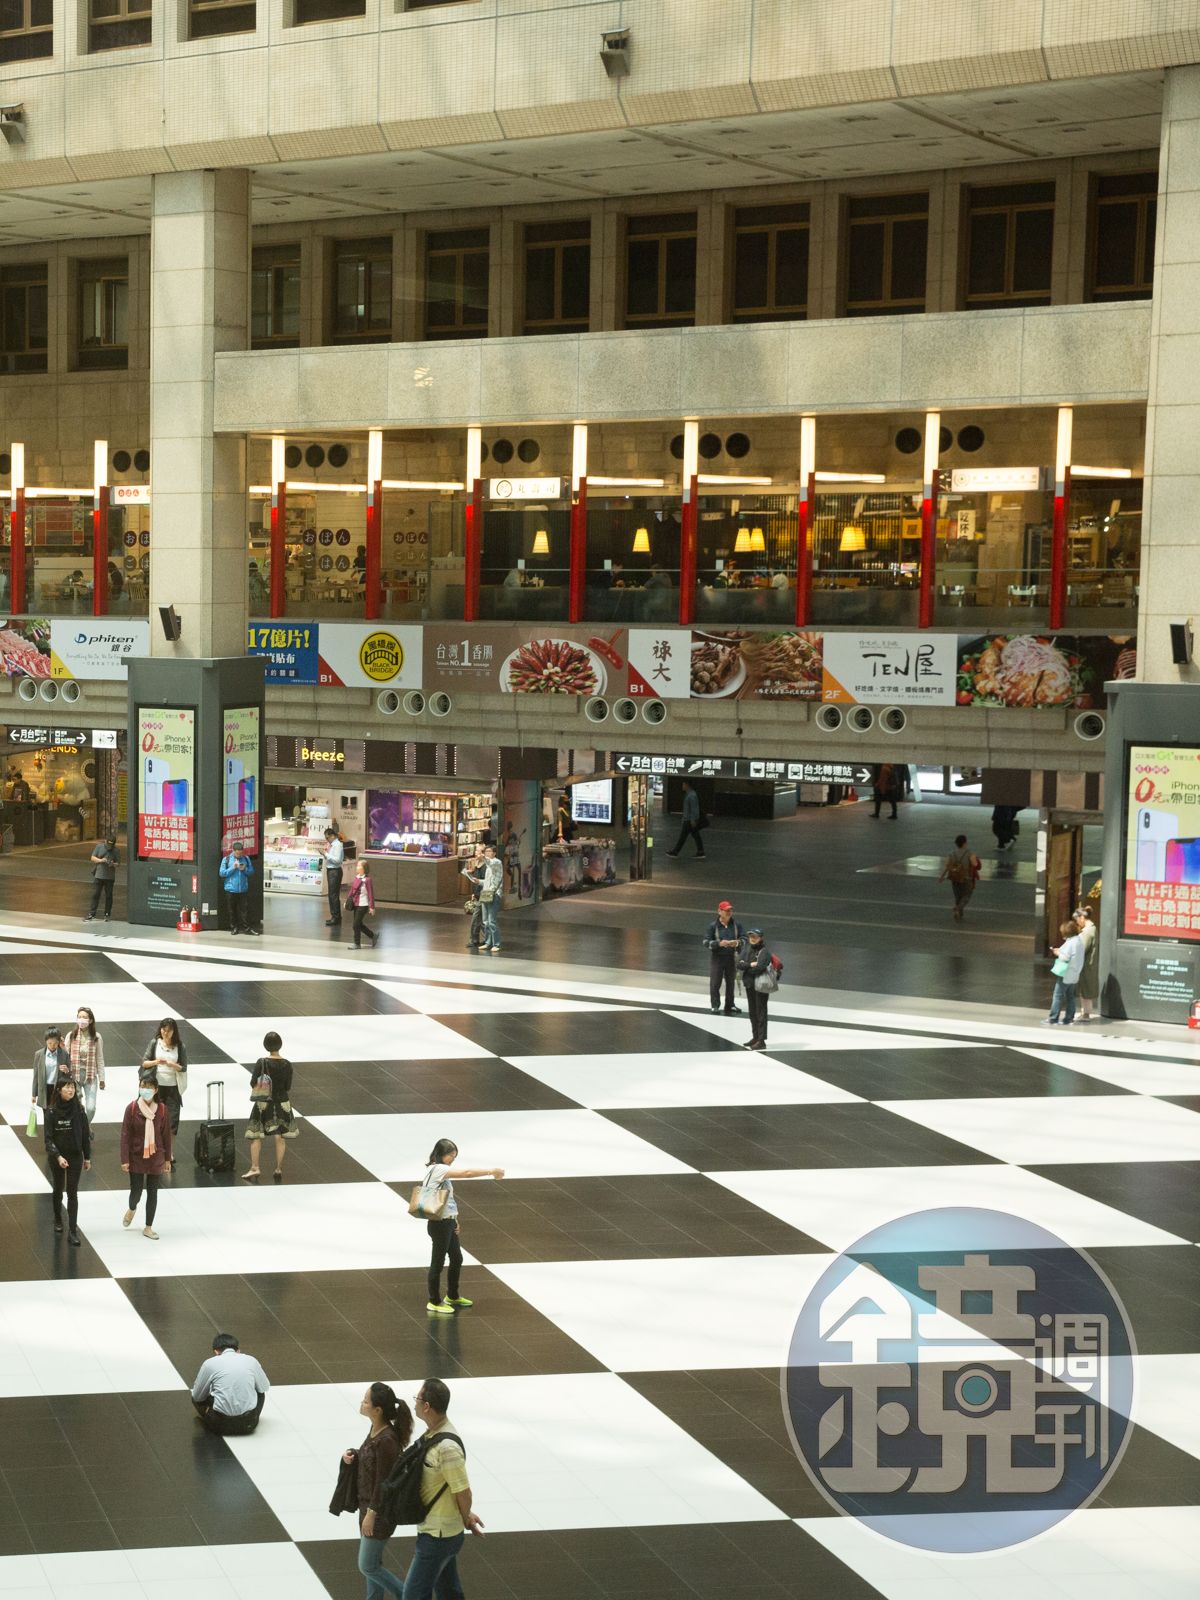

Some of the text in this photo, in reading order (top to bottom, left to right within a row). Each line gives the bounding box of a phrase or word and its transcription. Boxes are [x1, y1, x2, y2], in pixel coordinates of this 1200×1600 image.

[304, 531, 347, 544] おぼん
[88, 634, 135, 645] phiten
[54, 667, 64, 676] 1F
[320, 674, 333, 683] B1
[629, 684, 644, 693] B1
[825, 689, 841, 699] 2F
[20, 728, 34, 739] 月台
[301, 748, 345, 762] Breeze
[631, 756, 853, 777] 月台 台鐵 高鐵 捷運 台北轉運站
[833, 776, 855, 784] Station
[226, 837, 255, 850] 上到飽
